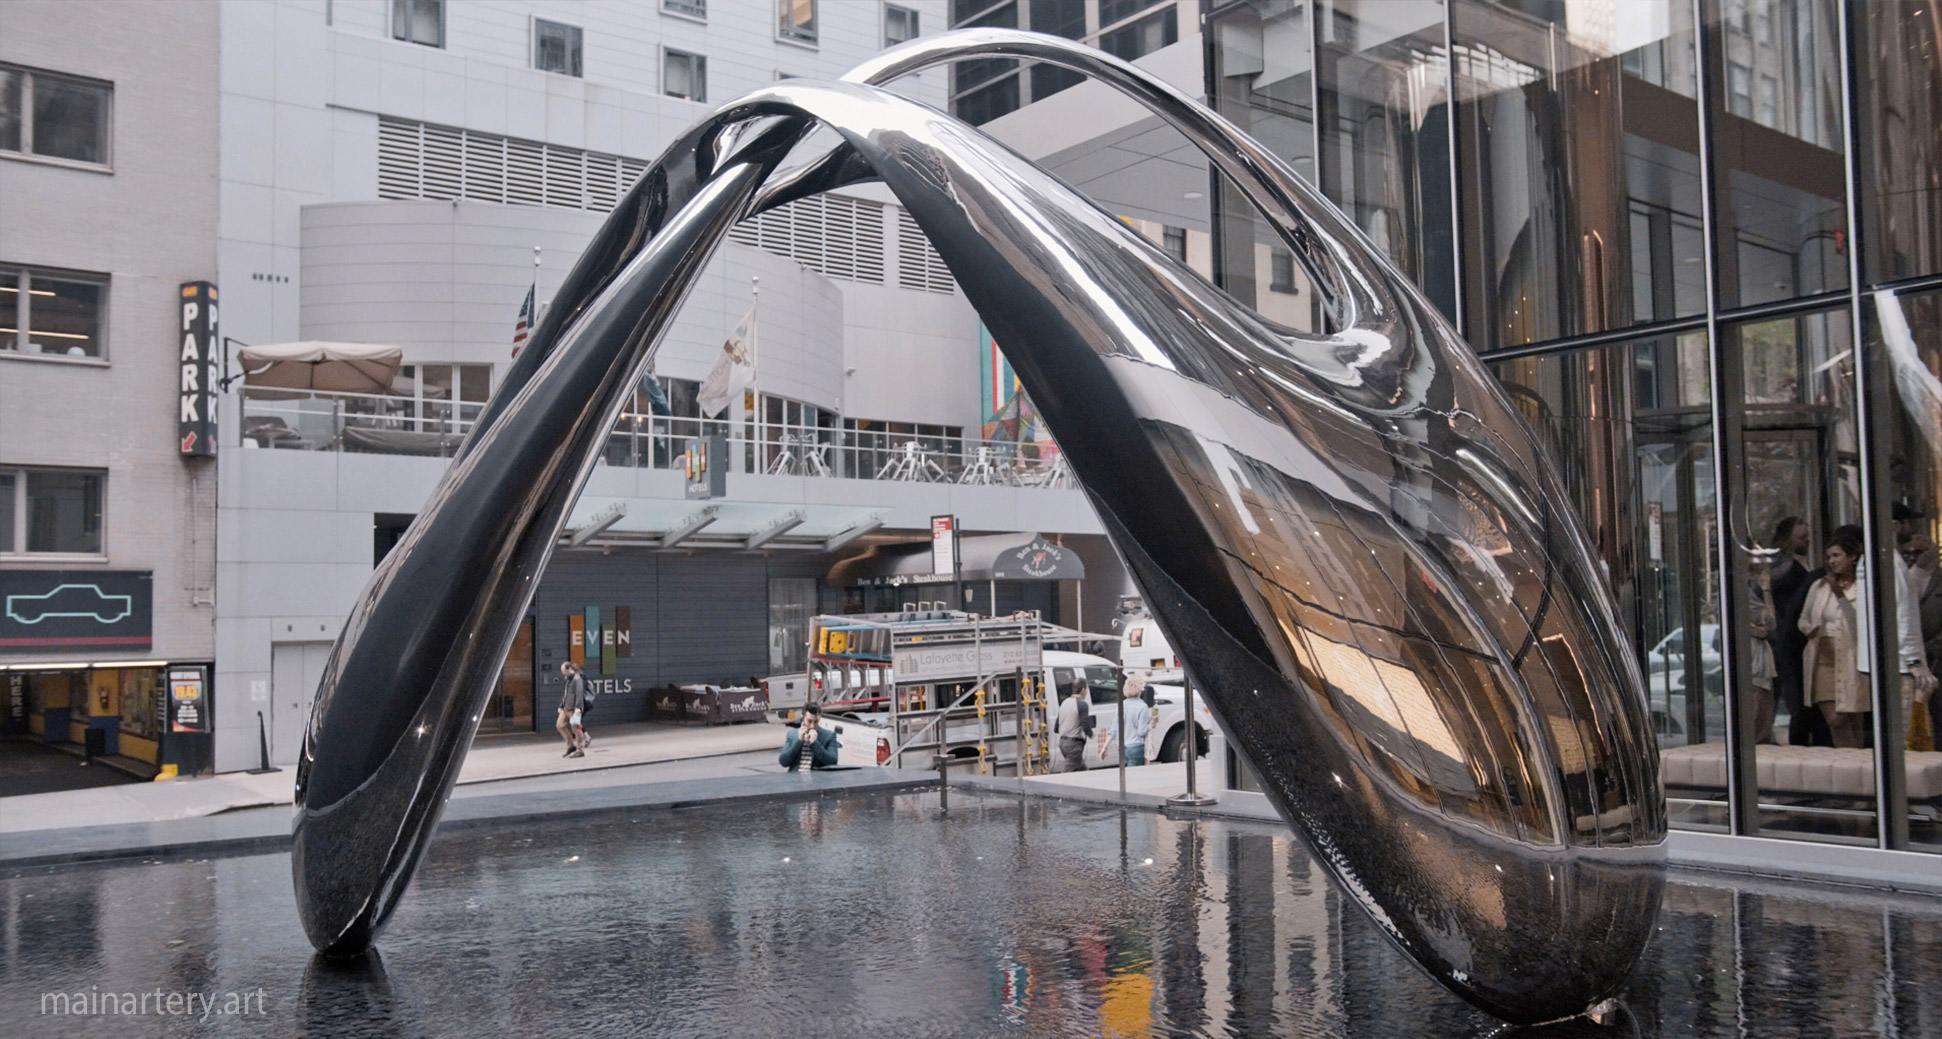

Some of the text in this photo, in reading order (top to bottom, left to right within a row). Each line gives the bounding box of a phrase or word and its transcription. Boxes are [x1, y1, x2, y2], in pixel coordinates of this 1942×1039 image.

[181, 302, 199, 422] PARK
[207, 304, 218, 424] PARK
[1016, 542, 1062, 561] Ben & Jack's
[1022, 563, 1057, 577] Steakhouse
[857, 578, 871, 586] Ben
[874, 577, 881, 585] &
[913, 573, 953, 583] Steakhouse
[572, 630, 630, 646] EVEN
[591, 679, 632, 694] TELS
